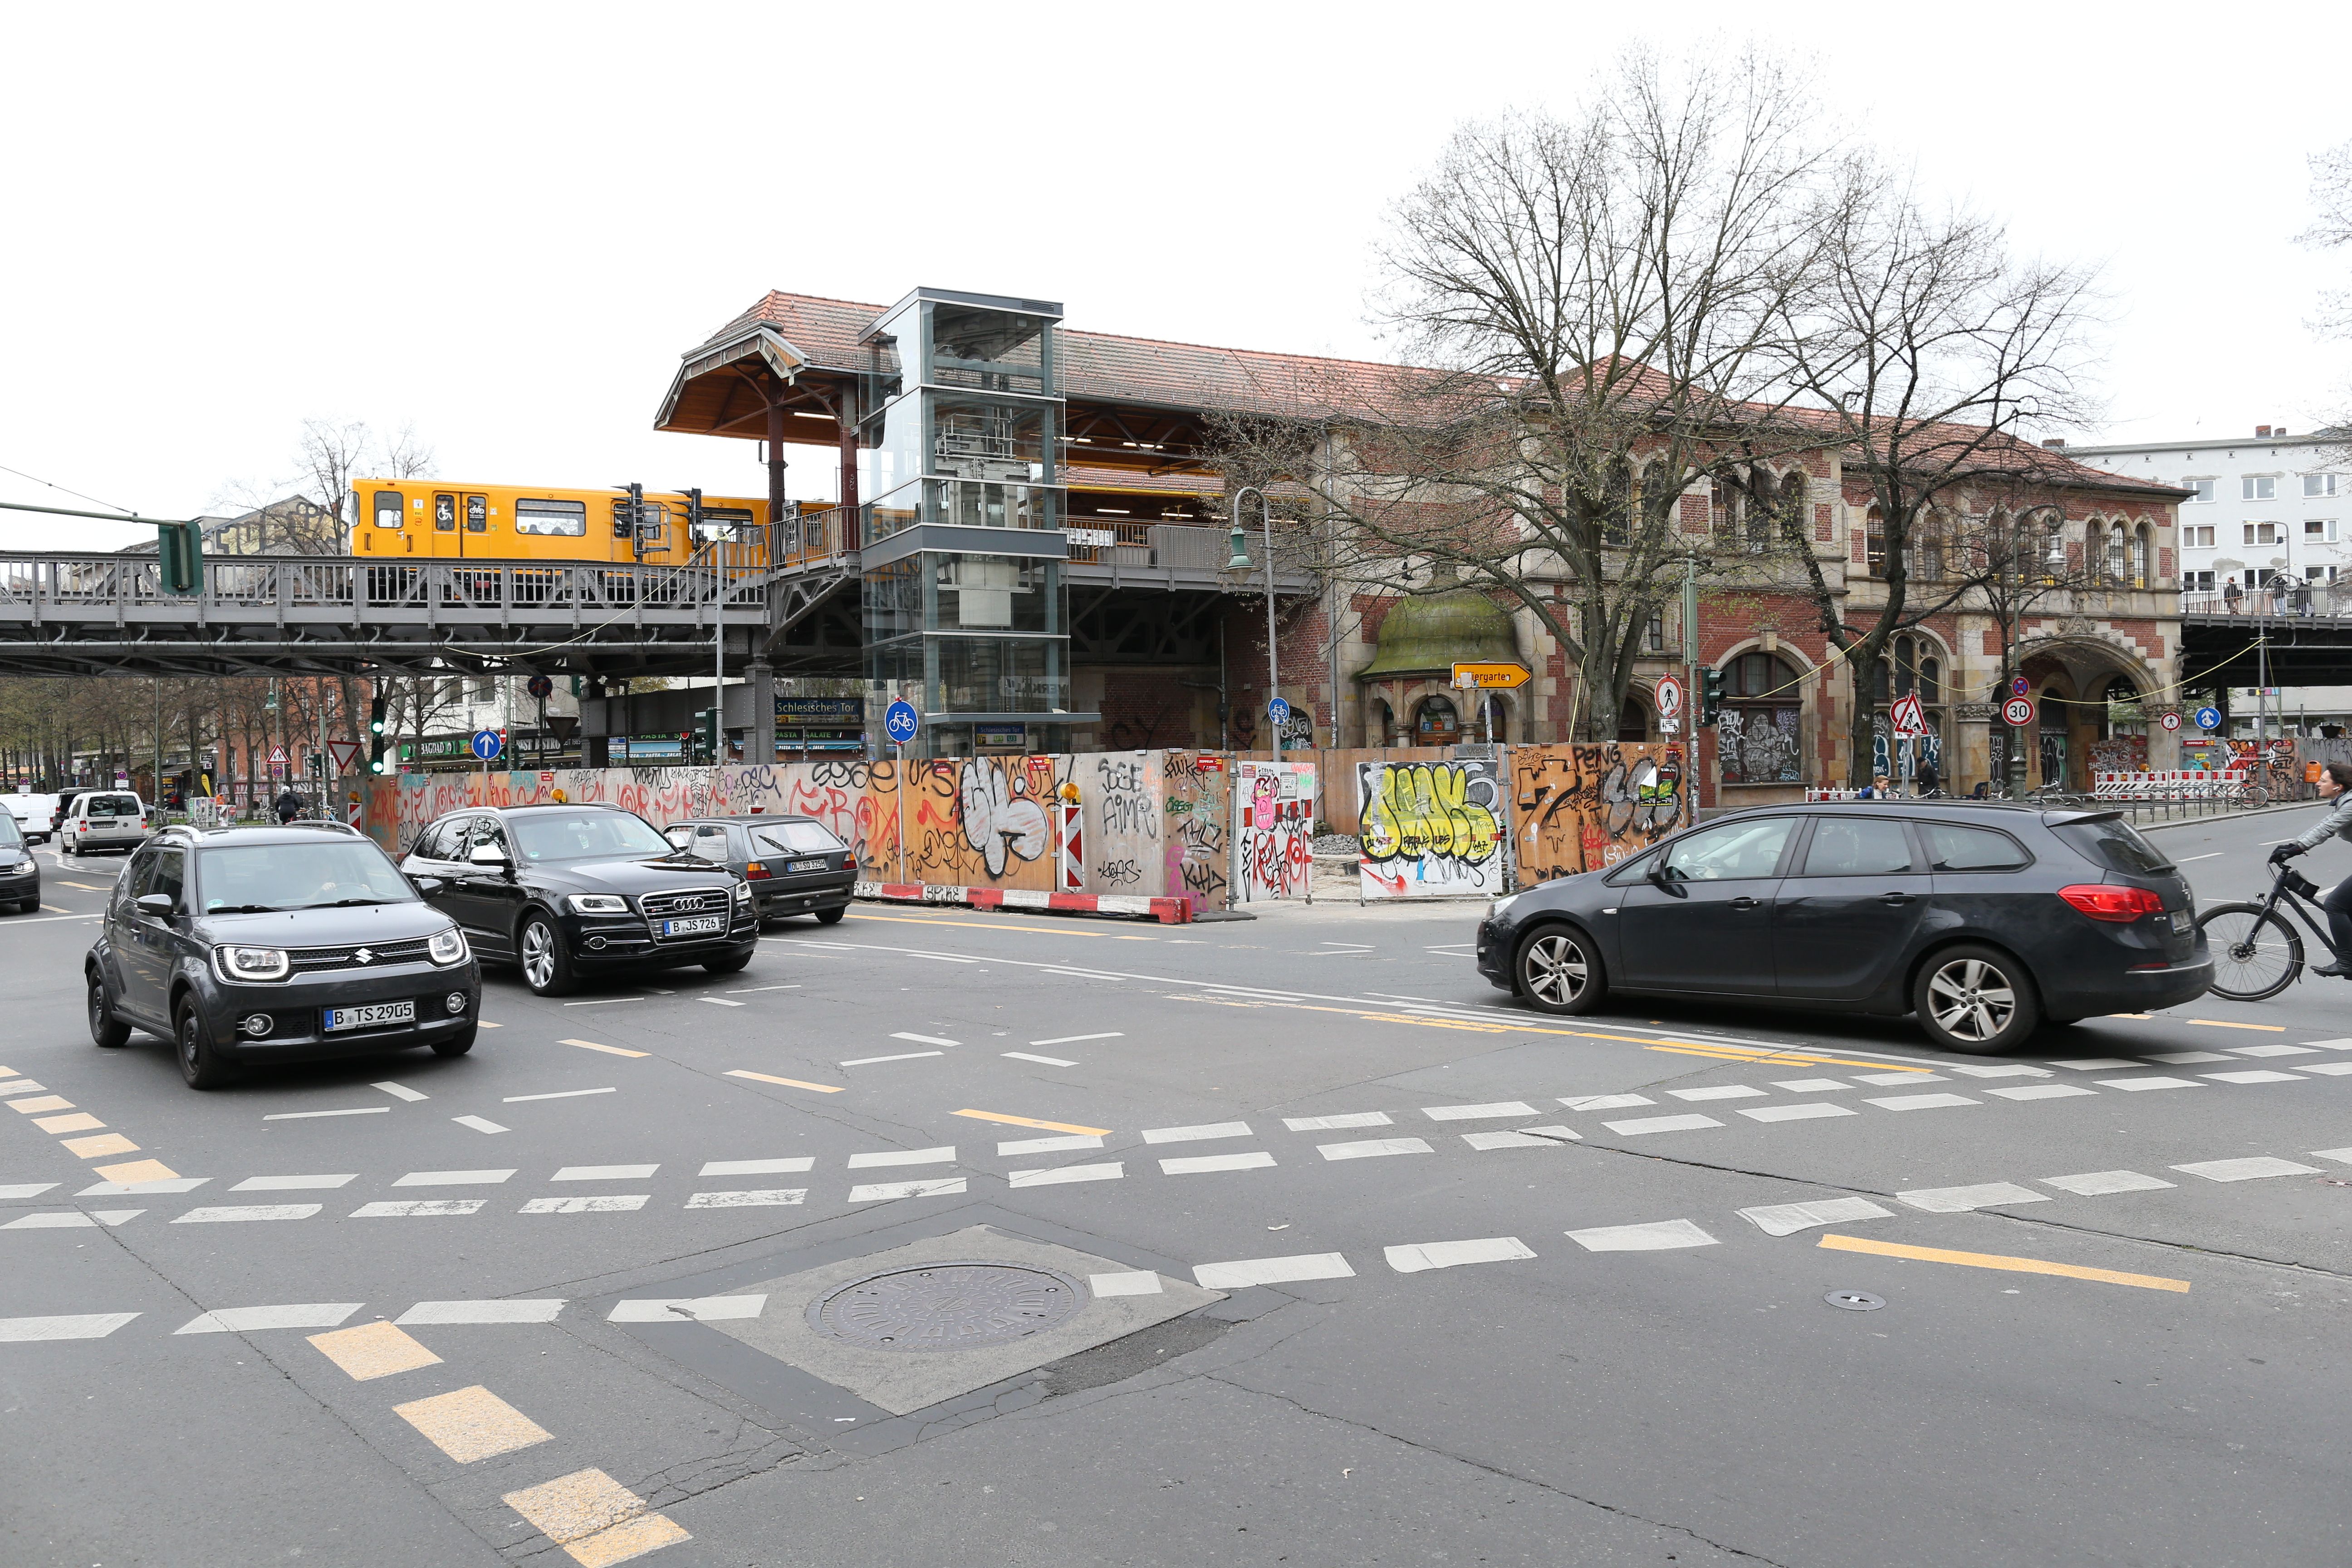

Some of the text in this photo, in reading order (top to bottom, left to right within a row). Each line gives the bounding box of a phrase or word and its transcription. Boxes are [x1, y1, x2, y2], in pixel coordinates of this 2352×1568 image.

[1470, 672, 1511, 683] iergarten
[777, 702, 855, 712] Schlesisches Tor
[2009, 705, 2027, 718] 30
[421, 742, 445, 755] BAGDAD
[516, 739, 533, 751] BEST
[534, 737, 561, 750] BSTRO
[811, 860, 825, 868] 325H
[673, 922, 680, 932] B
[686, 920, 698, 931] JS
[699, 918, 716, 930] 726
[334, 1011, 344, 1025] B
[354, 1007, 373, 1022] TS
[377, 1003, 412, 1020] 2905
